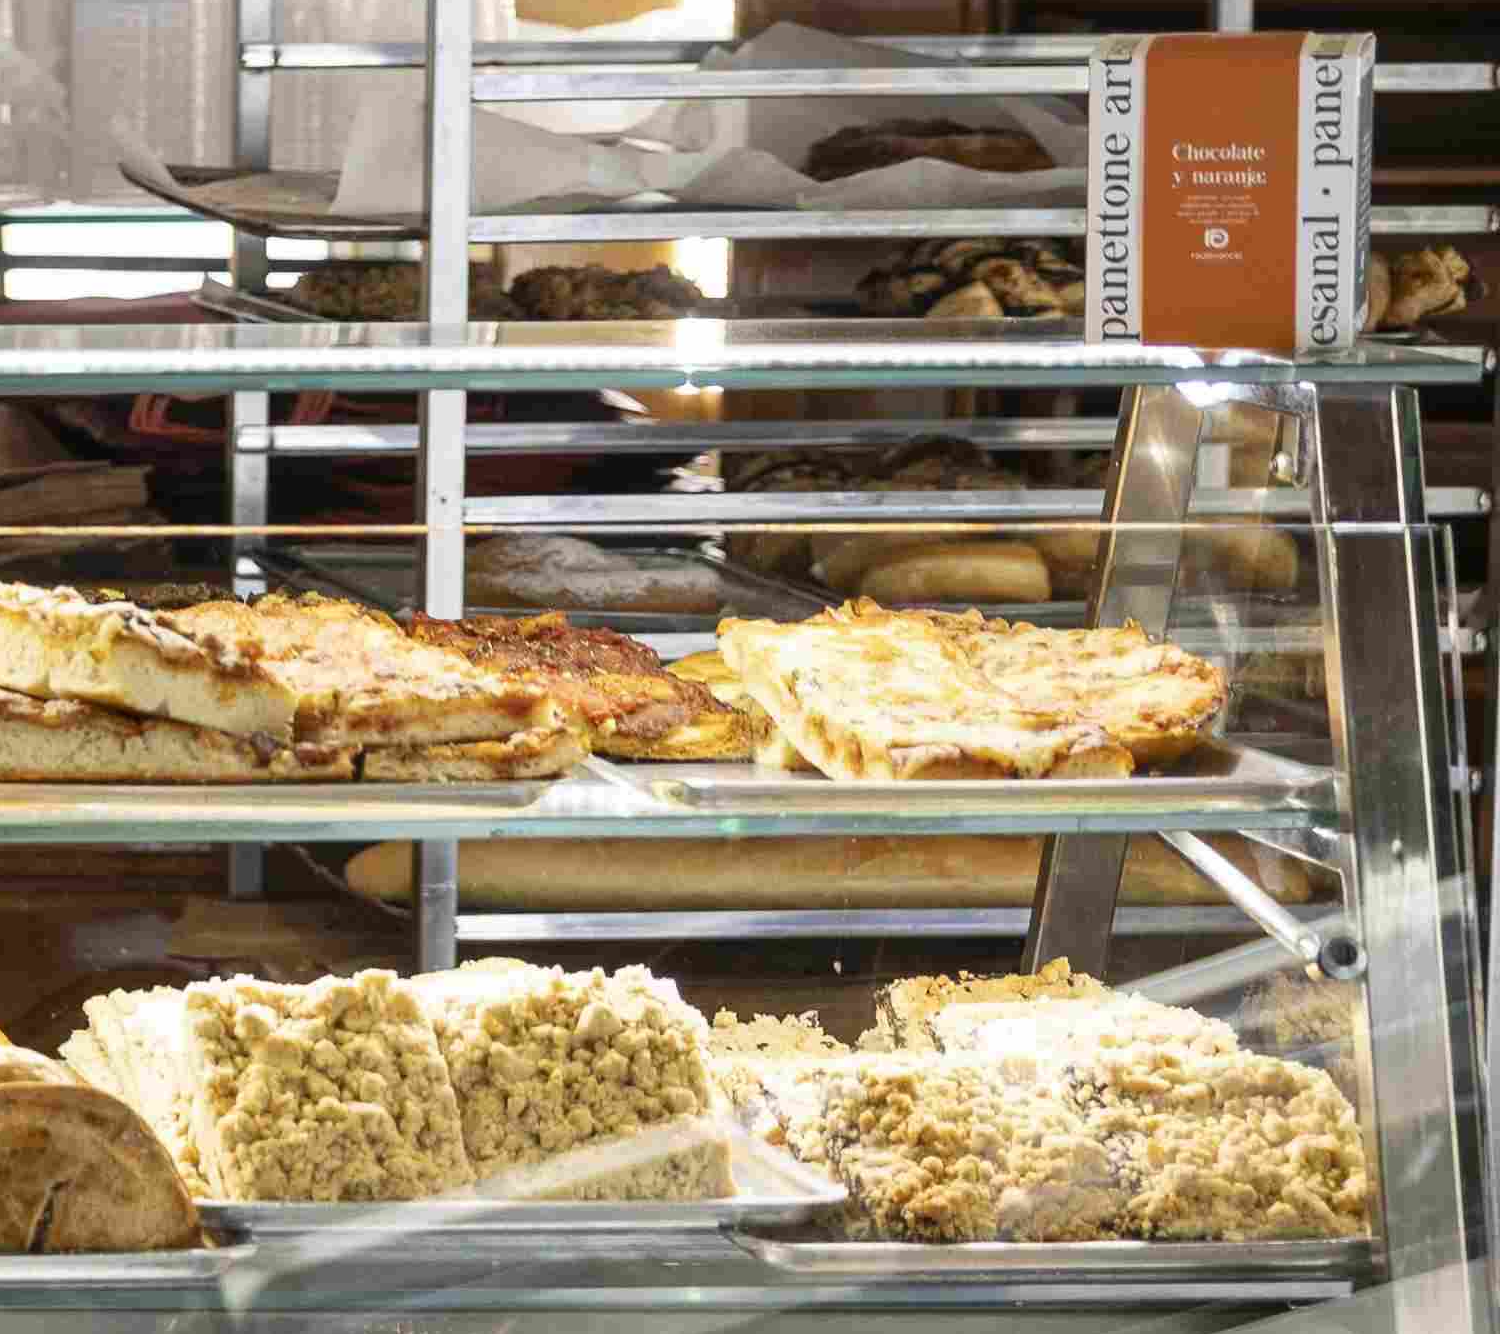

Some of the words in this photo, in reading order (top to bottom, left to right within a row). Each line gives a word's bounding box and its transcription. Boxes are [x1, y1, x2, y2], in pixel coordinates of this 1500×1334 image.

[1171, 142, 1266, 162] Chocolate
[1172, 170, 1183, 189] y
[1191, 166, 1268, 188] naranja:
[1098, 131, 1141, 343] panettone
[1302, 215, 1341, 347] esanal
